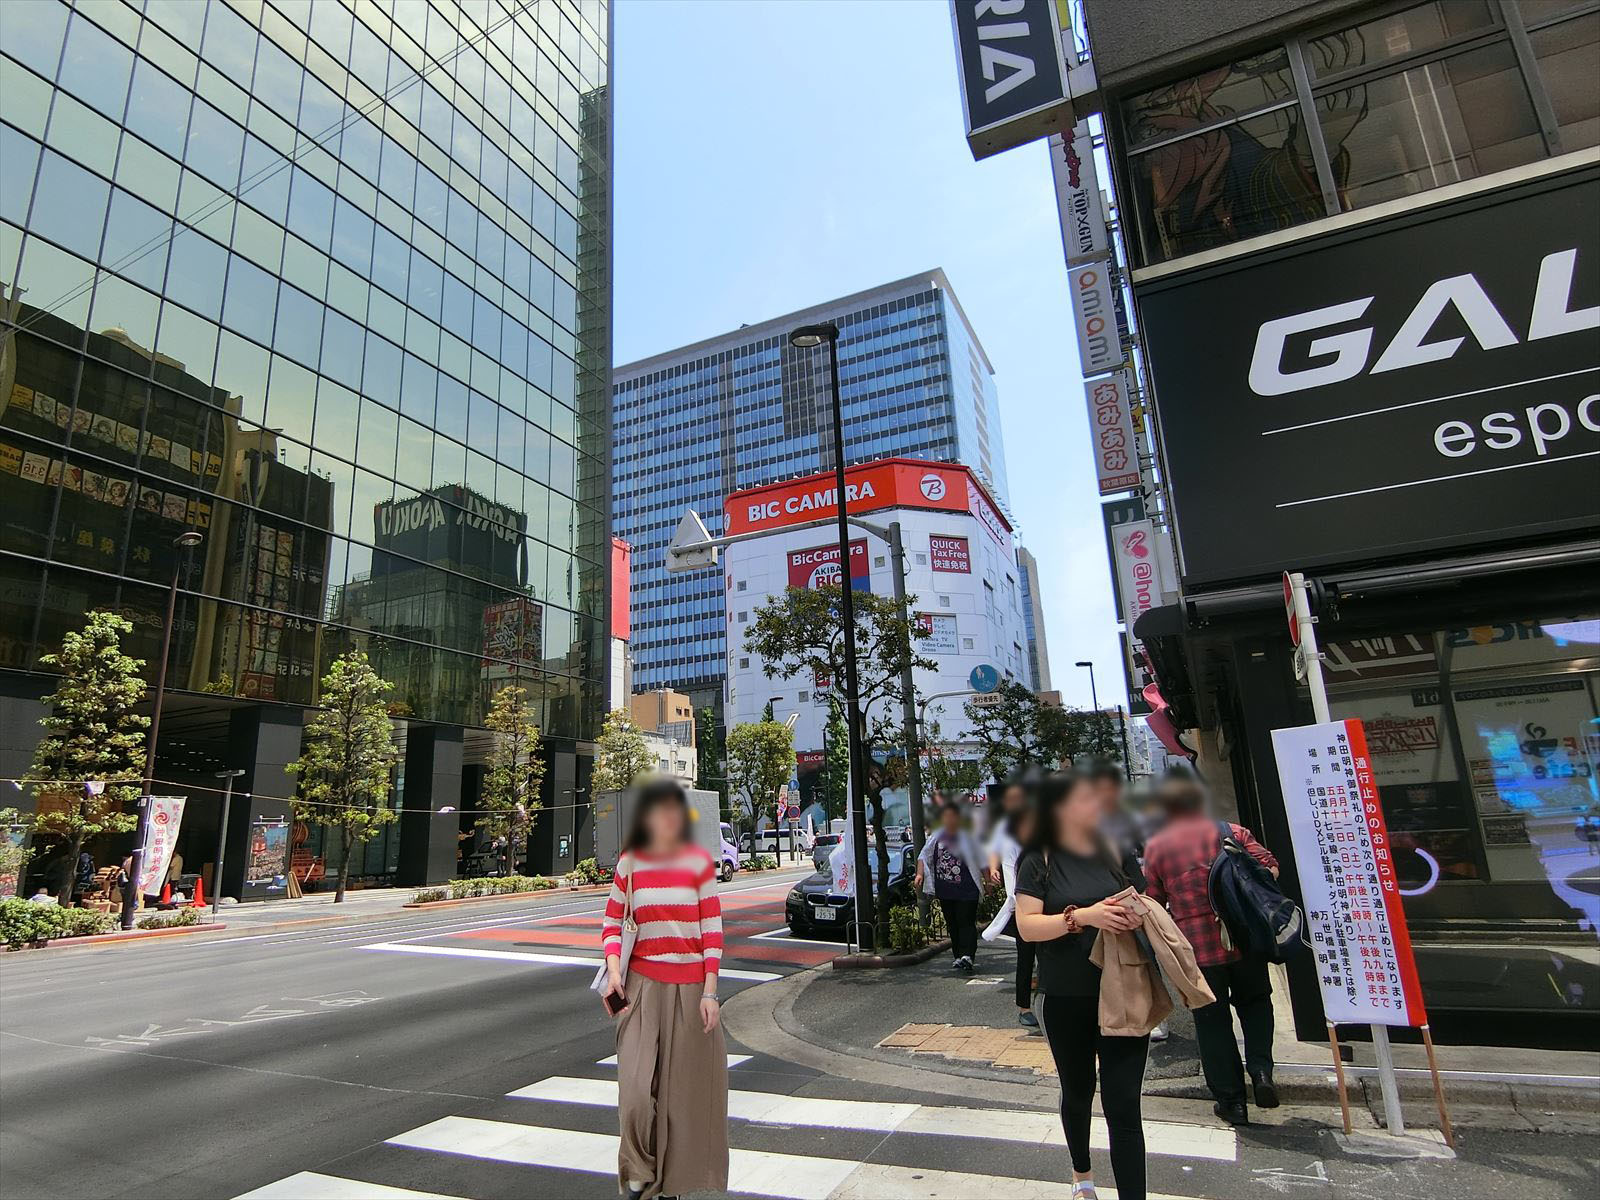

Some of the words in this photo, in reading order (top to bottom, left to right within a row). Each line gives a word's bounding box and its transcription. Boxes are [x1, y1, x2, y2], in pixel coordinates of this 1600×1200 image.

[1079, 271, 1110, 365] amiami
[1093, 383, 1128, 471] あみあみ
[748, 501, 781, 522] BIC
[792, 545, 864, 566] BicCamra
[931, 540, 960, 550] QUICK
[932, 548, 948, 558] Tax
[948, 550, 967, 559] Free
[814, 565, 841, 577] AKIBA
[933, 559, 968, 570] 快速免税
[1355, 757, 1394, 892] 通行止めのお知らせ
[1310, 911, 1333, 986] 神田明神
[1319, 911, 1342, 987] 万世橋警察署
